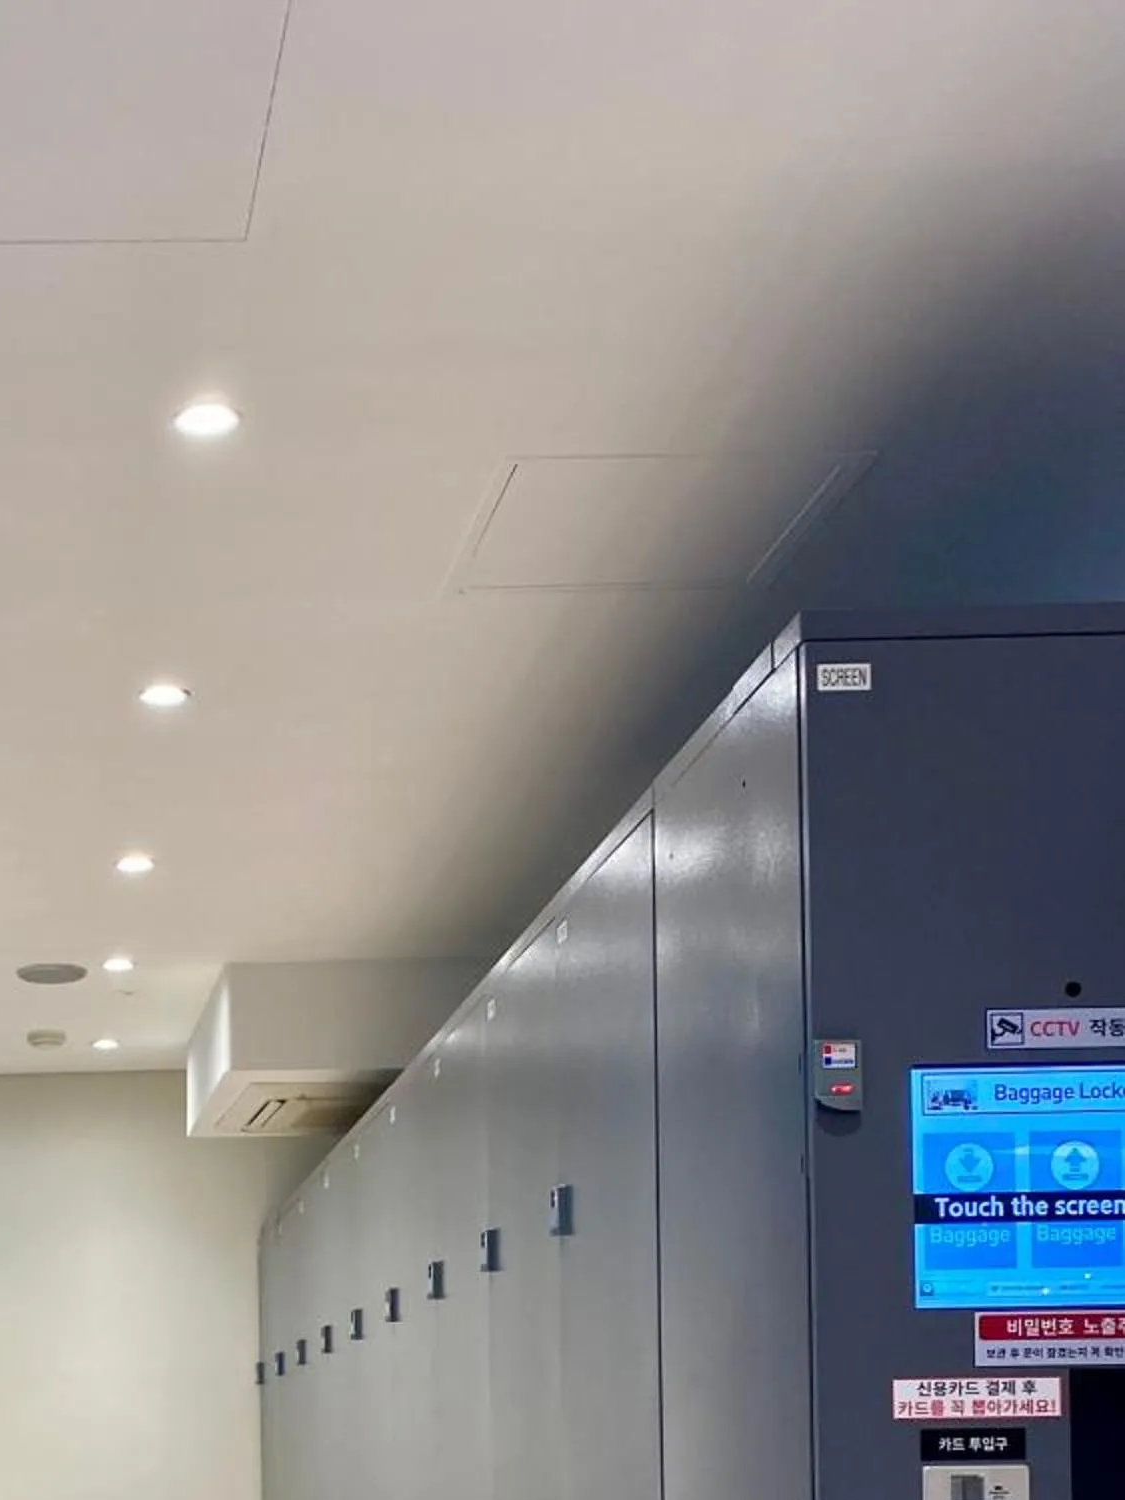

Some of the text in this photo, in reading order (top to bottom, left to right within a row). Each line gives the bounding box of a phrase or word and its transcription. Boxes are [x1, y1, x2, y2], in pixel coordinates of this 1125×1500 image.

[821, 668, 867, 688] SCREEN
[1030, 1021, 1080, 1037] CCTV
[994, 1082, 1125, 1104] Baggage Lock
[934, 1194, 1125, 1218] Touch the screen
[930, 1226, 1011, 1247] Baggage
[1036, 1224, 1116, 1245] Baggage
[1006, 1317, 1075, 1337] 비밀번호
[916, 1379, 1039, 1397] 신용카드 결제 후
[897, 1399, 945, 1417] 카드를
[938, 1436, 1009, 1452] 카드 투입구
